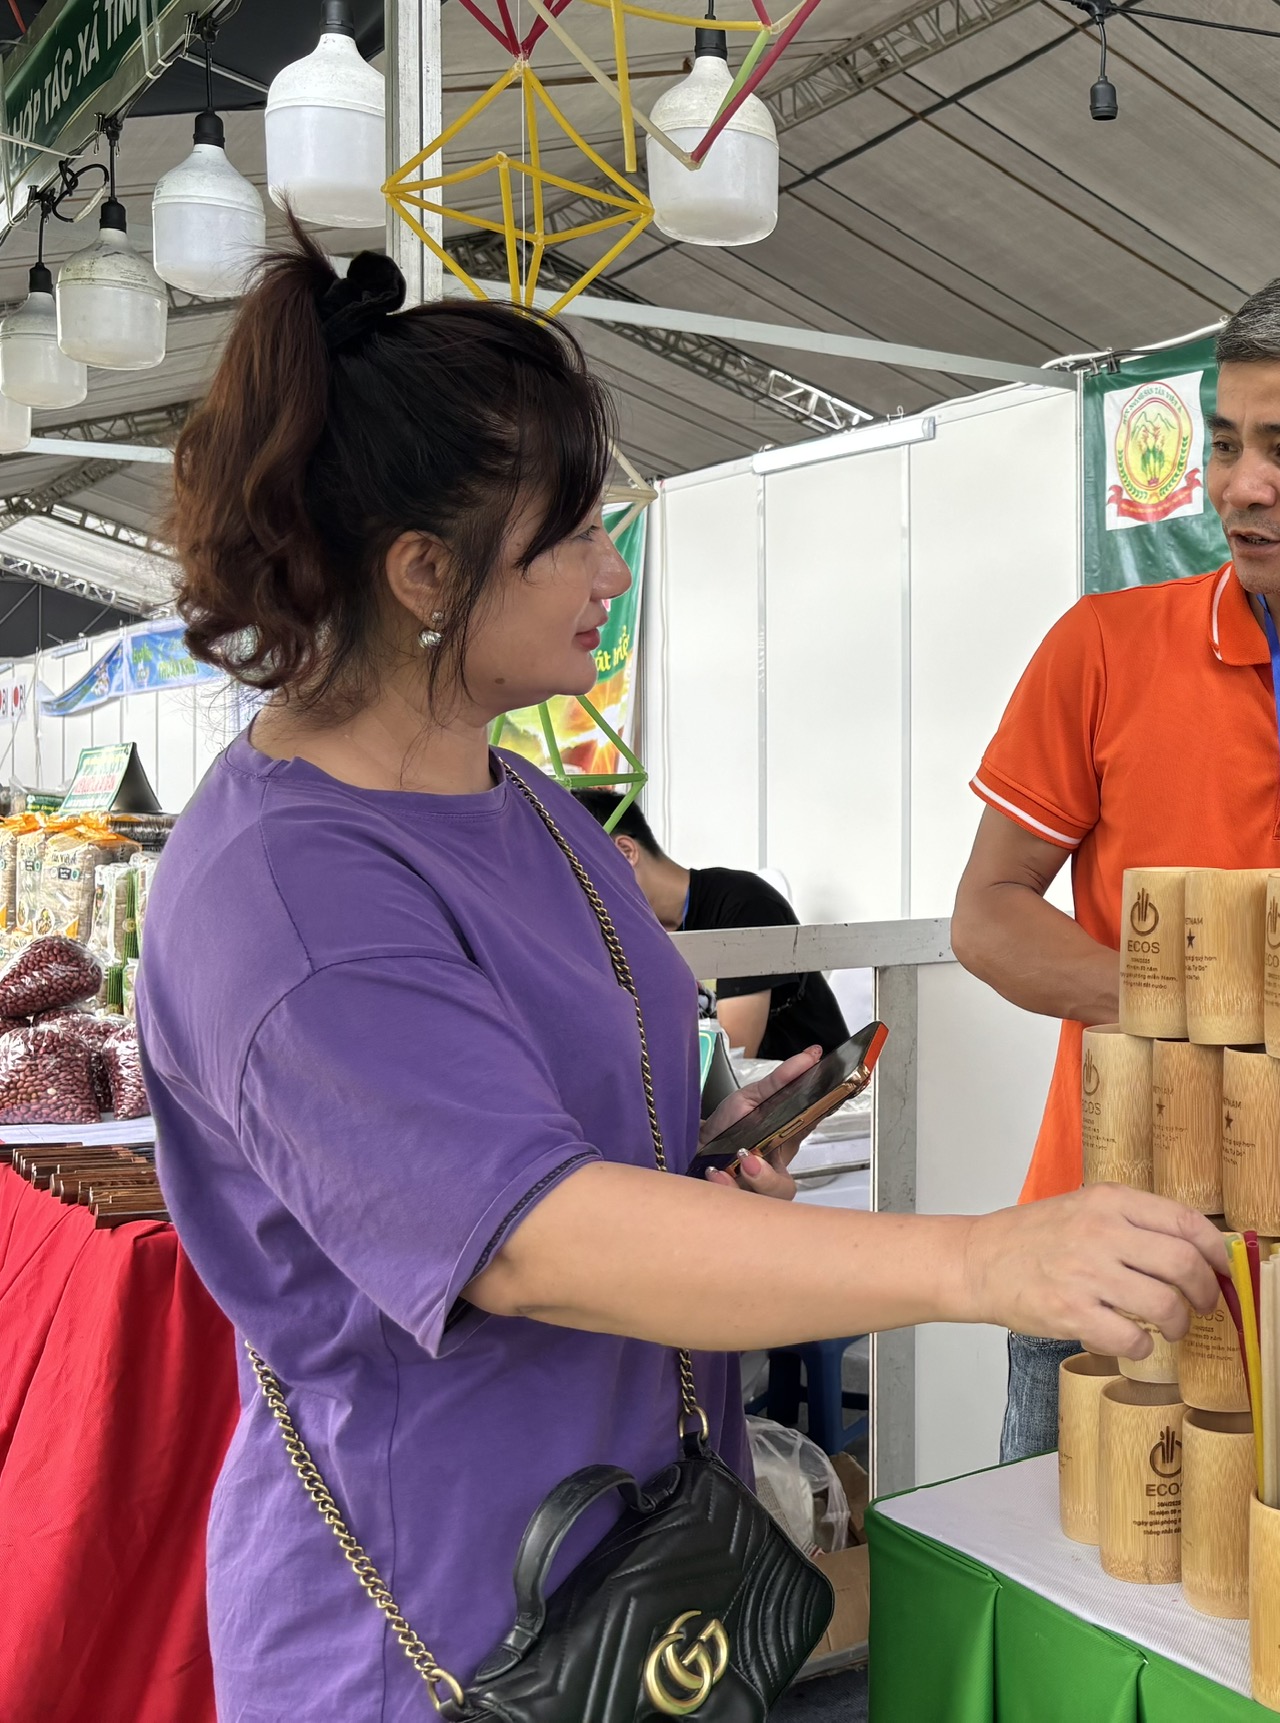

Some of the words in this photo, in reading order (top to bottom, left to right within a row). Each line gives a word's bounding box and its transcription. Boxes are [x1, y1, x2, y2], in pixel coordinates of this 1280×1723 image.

[44, 45, 73, 124] TÁC
[1127, 939, 1161, 954] ECOS
[1145, 1482, 1182, 1497] ECO
